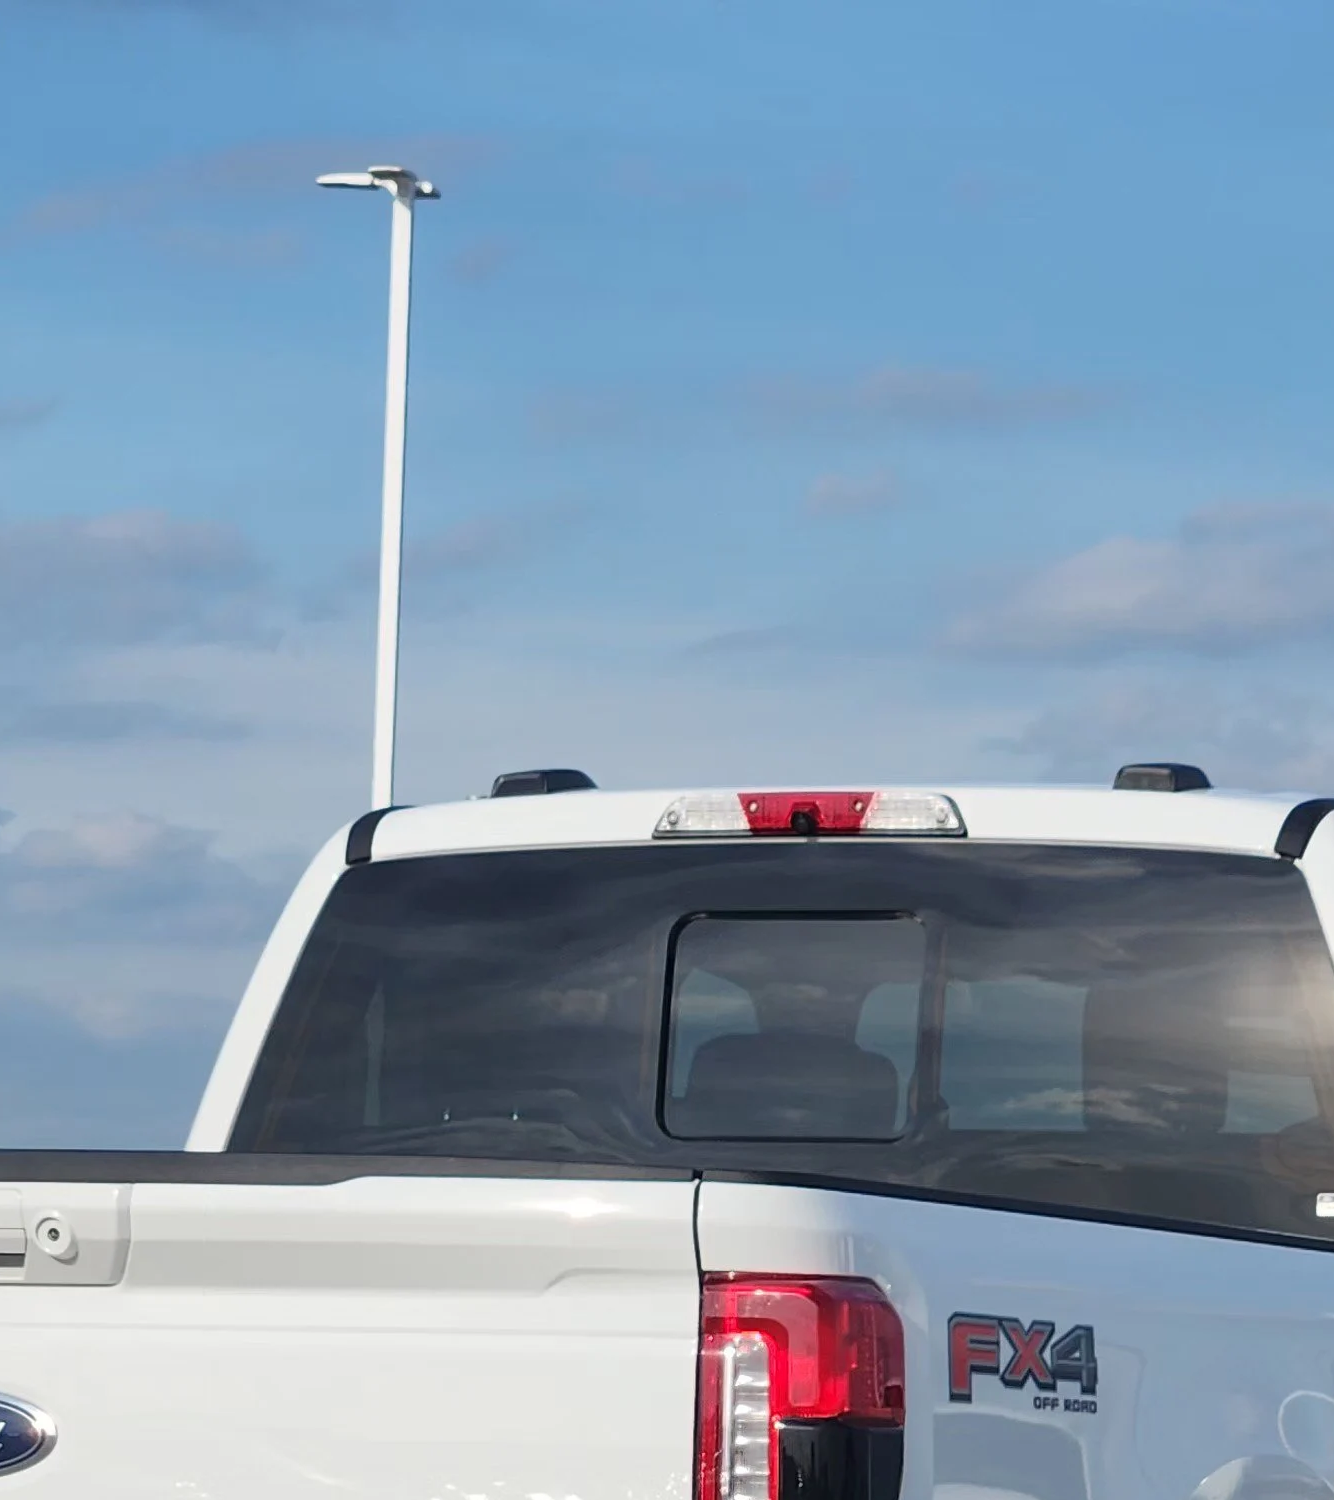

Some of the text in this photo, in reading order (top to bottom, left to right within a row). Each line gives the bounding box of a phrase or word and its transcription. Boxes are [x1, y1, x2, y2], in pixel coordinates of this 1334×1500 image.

[948, 1311, 1098, 1403] FX4
[1033, 1396, 1097, 1413] OFF ROAD
